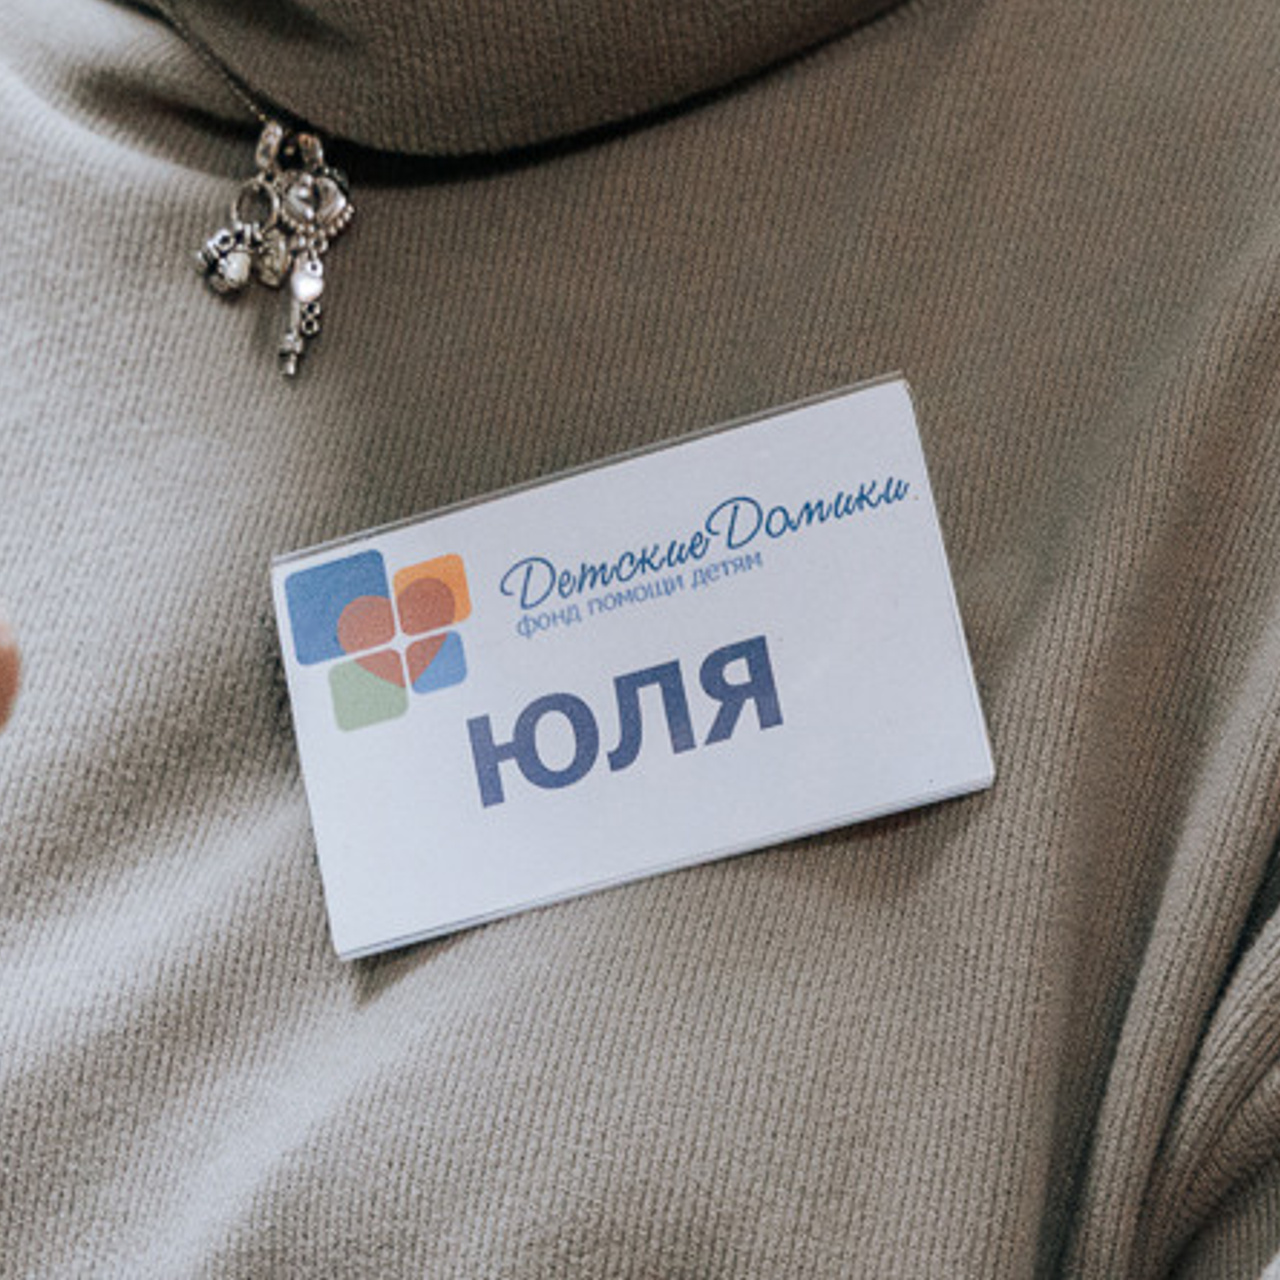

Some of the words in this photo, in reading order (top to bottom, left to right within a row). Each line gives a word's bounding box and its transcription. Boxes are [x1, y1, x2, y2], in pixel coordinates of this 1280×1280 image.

[516, 603, 582, 638] фонд
[588, 574, 685, 616] помощи
[691, 551, 764, 591] детям
[466, 635, 785, 809] ЮЛЯ
